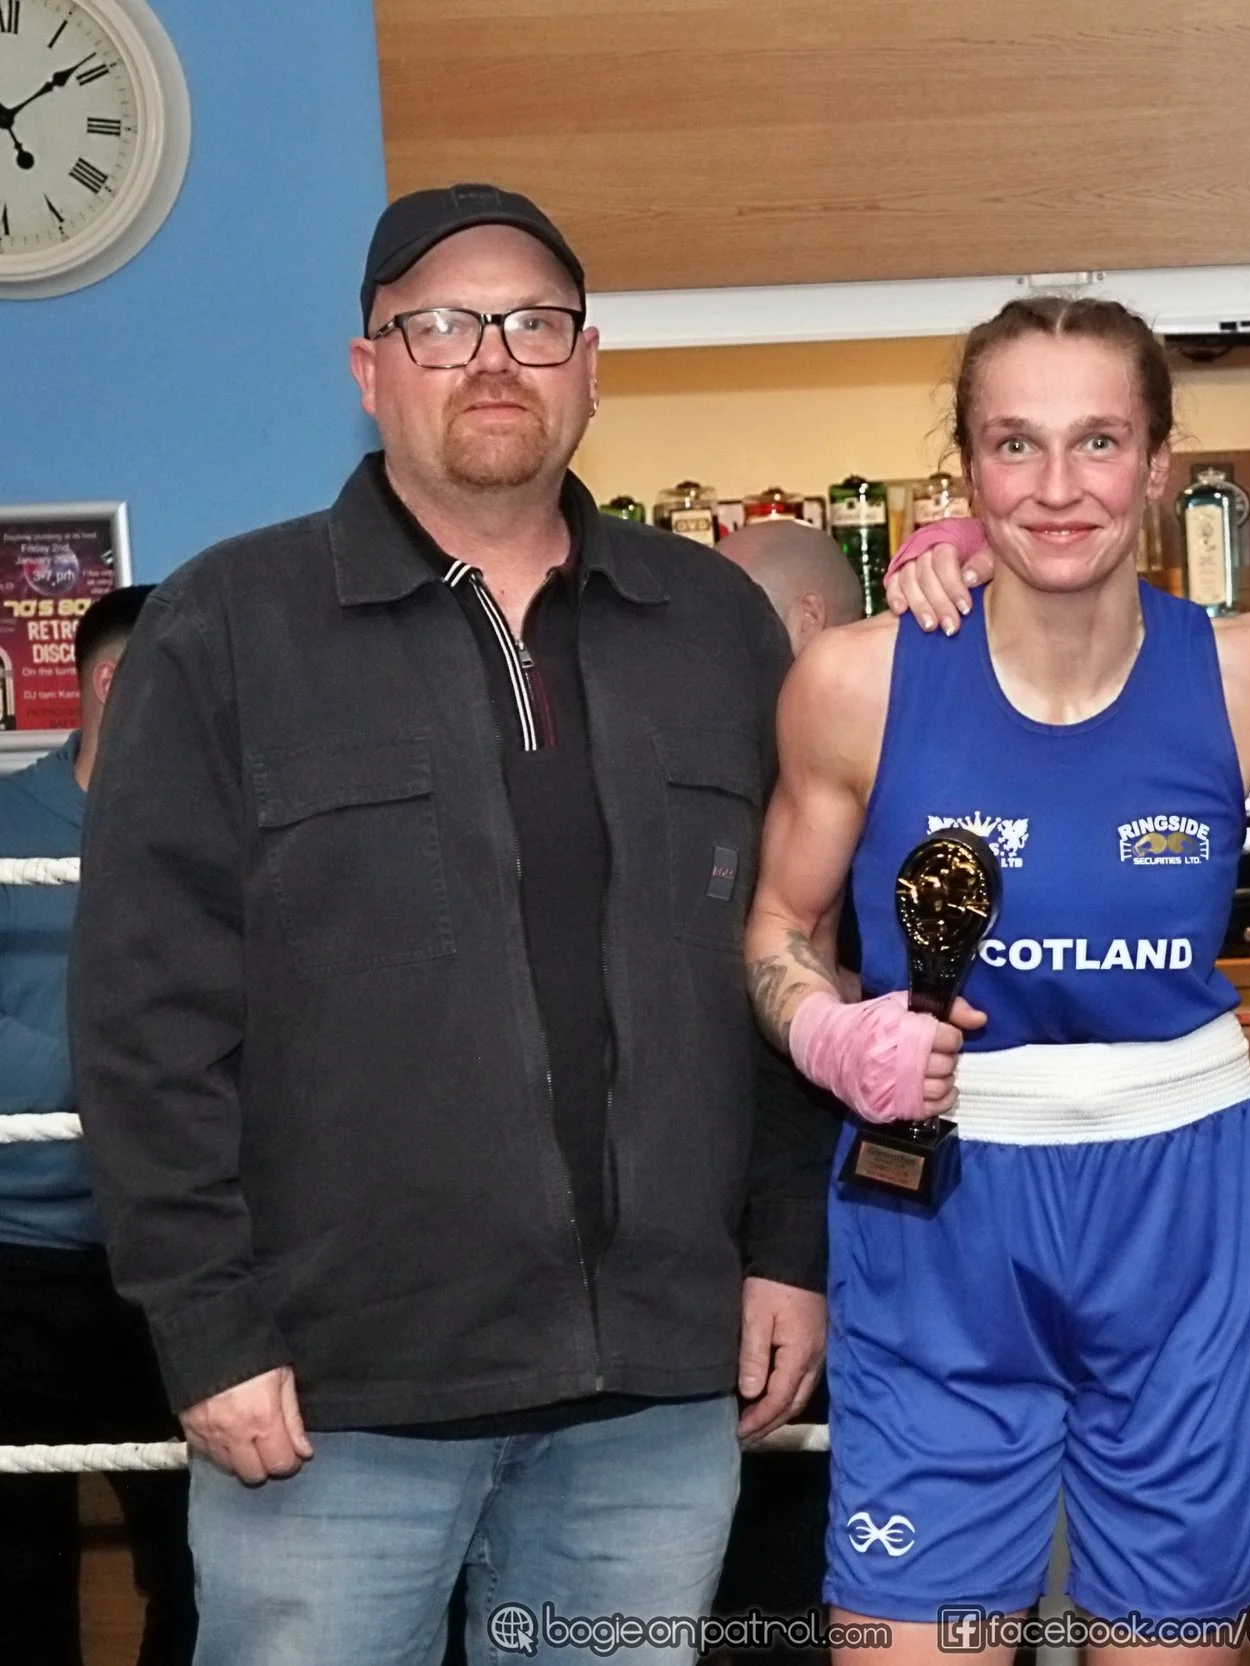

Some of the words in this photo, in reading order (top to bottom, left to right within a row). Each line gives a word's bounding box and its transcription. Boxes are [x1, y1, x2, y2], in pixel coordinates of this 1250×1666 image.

[21, 543, 50, 554] Friday
[1118, 815, 1210, 841] RINGSIDE
[1001, 858, 1023, 868] LTD
[1133, 857, 1182, 865] SECURITIES
[1185, 856, 1201, 864] LTD.
[978, 938, 1193, 970] COTLAND
